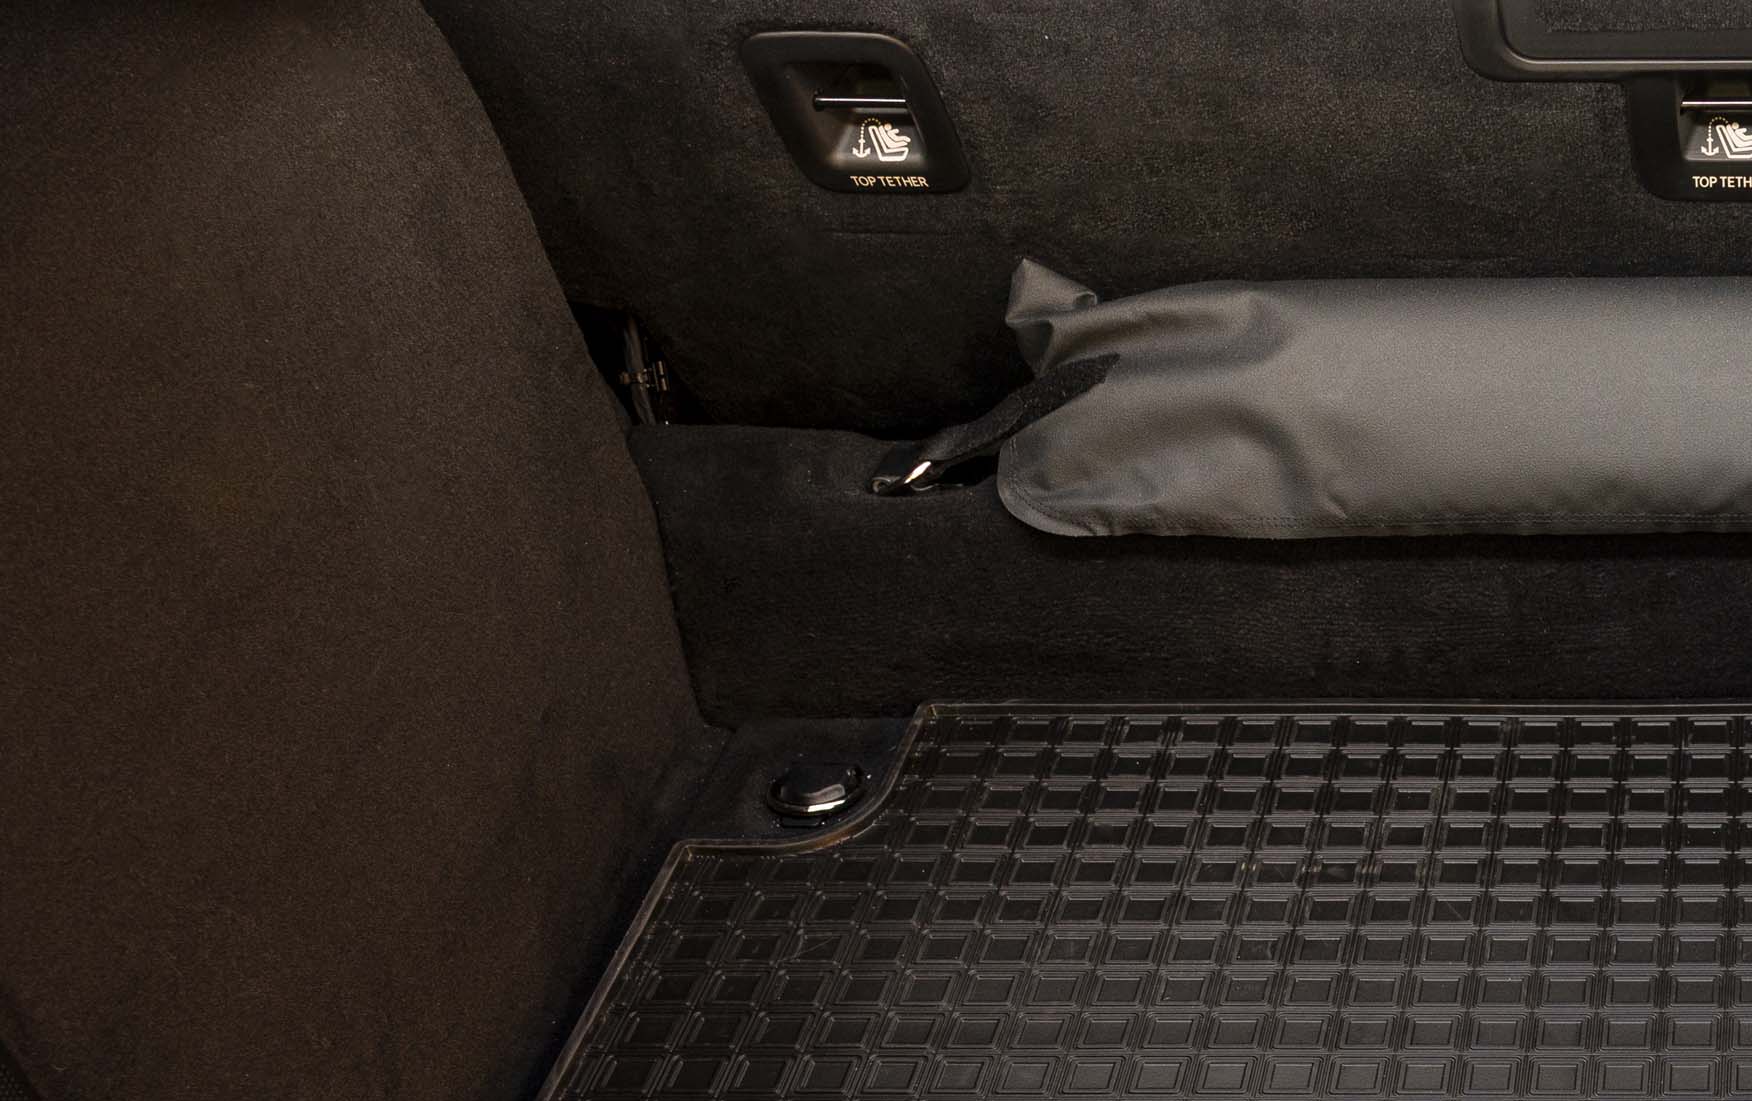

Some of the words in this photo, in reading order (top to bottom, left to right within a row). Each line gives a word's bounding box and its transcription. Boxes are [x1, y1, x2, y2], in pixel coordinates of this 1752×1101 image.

[849, 175, 877, 187] TOP
[877, 175, 930, 188] TETHER
[1691, 175, 1718, 188] TOP
